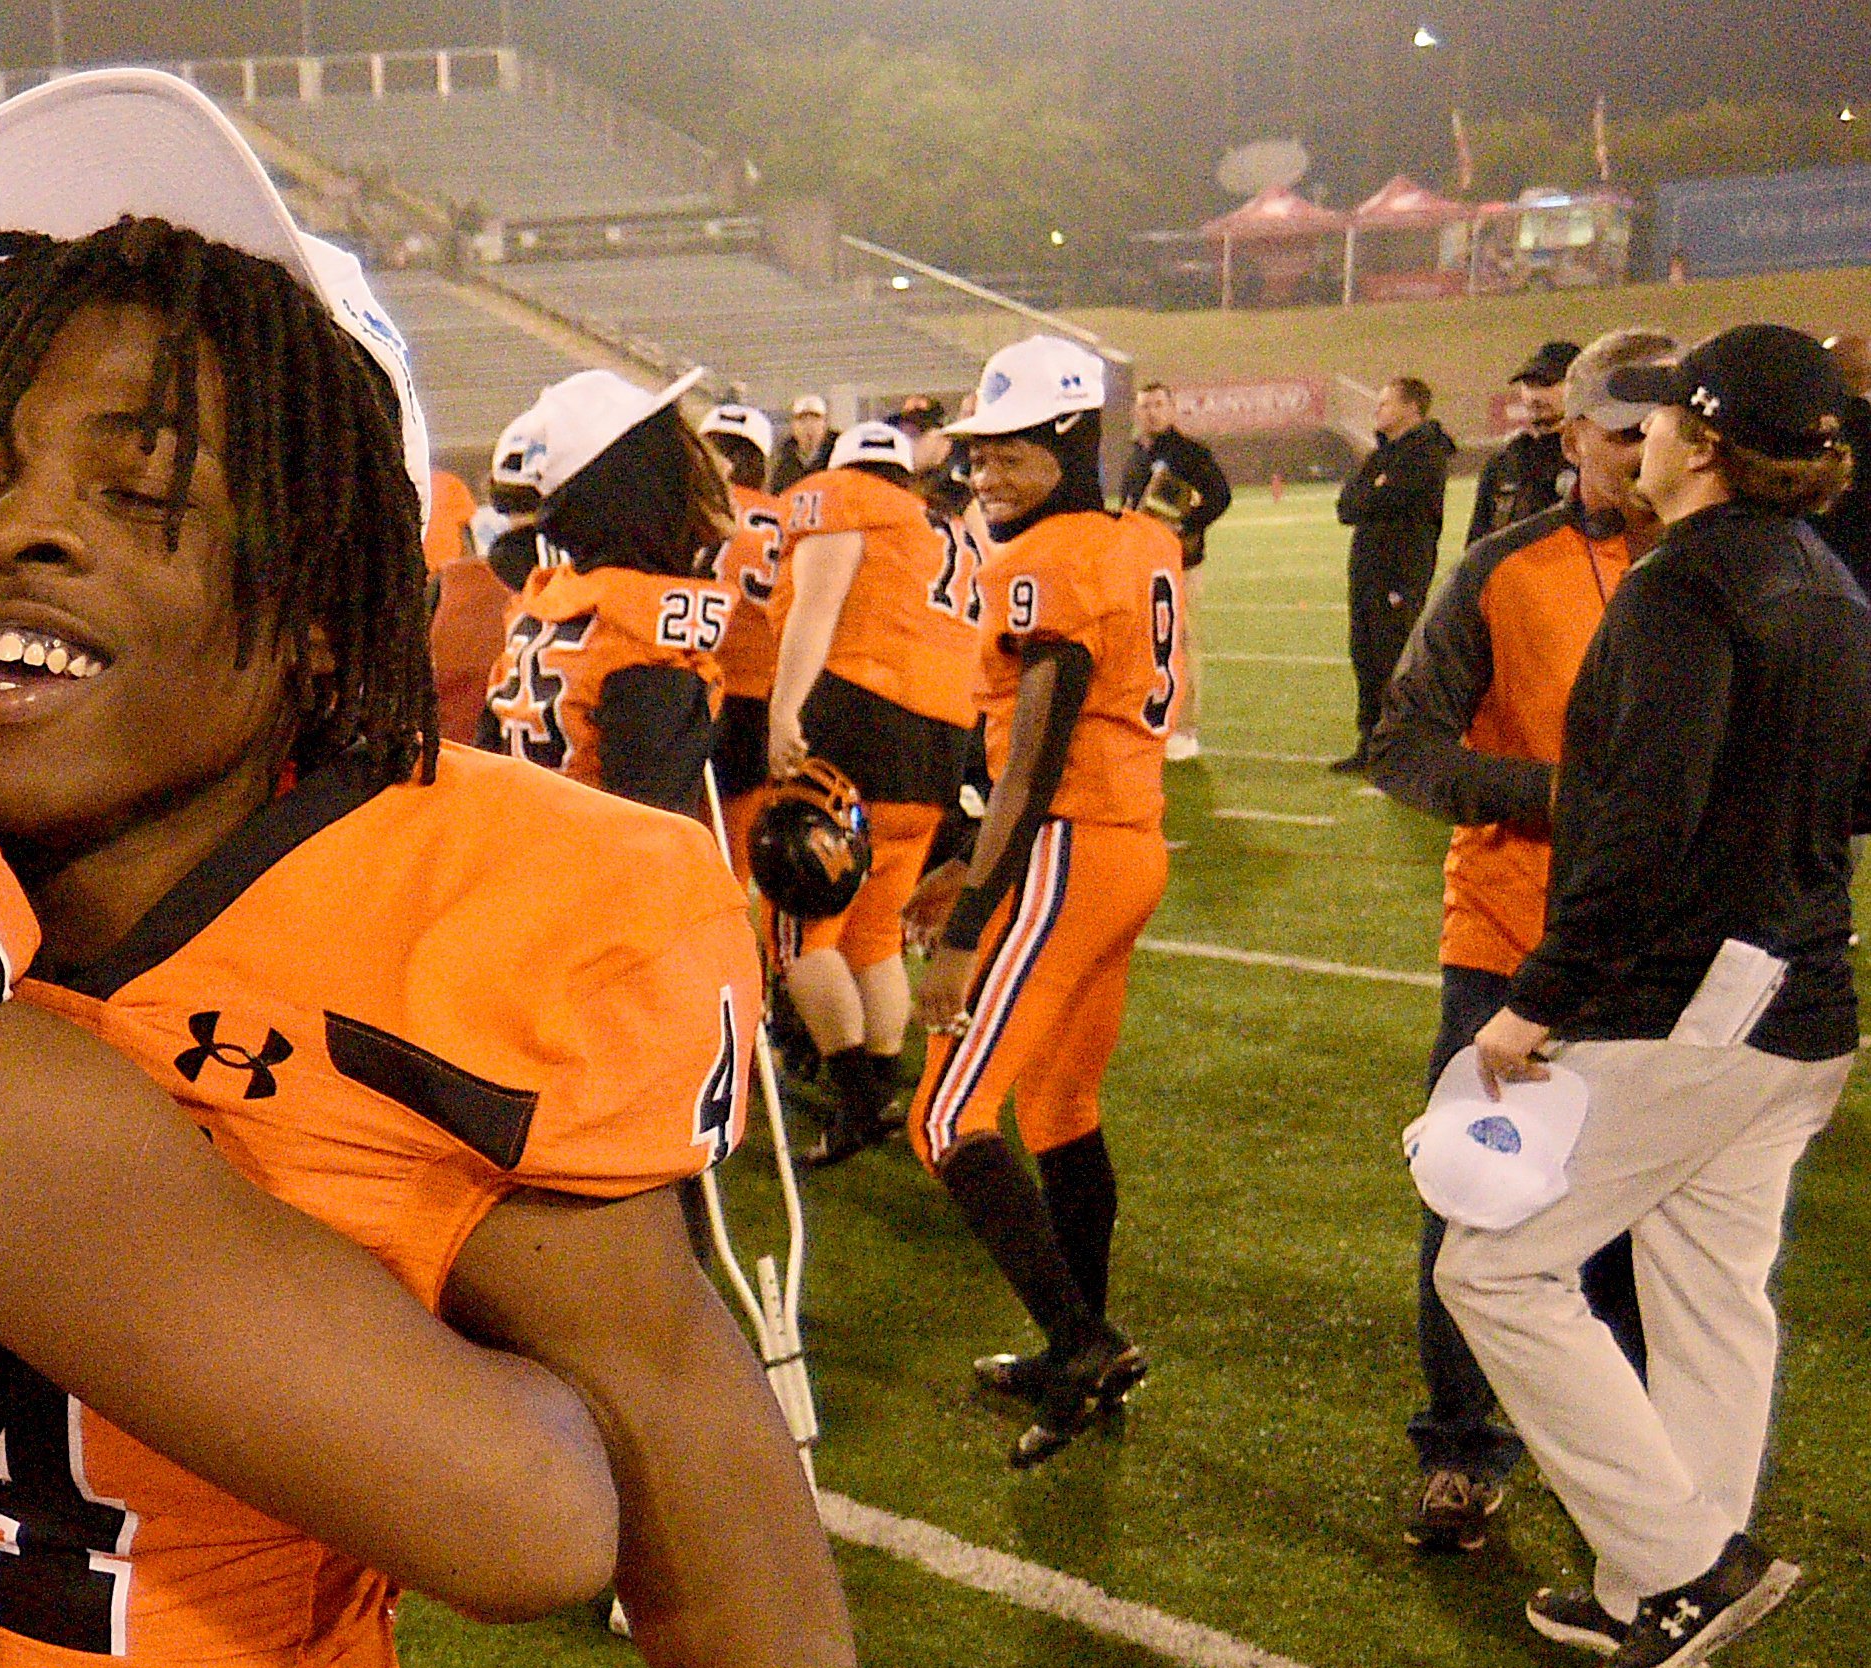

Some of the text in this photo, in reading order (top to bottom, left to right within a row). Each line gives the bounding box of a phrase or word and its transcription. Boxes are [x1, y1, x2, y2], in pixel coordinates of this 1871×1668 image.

[656, 586, 732, 653] 25
[1008, 573, 1037, 632] 9
[1140, 570, 1177, 733] 9
[689, 985, 738, 1172] 4
